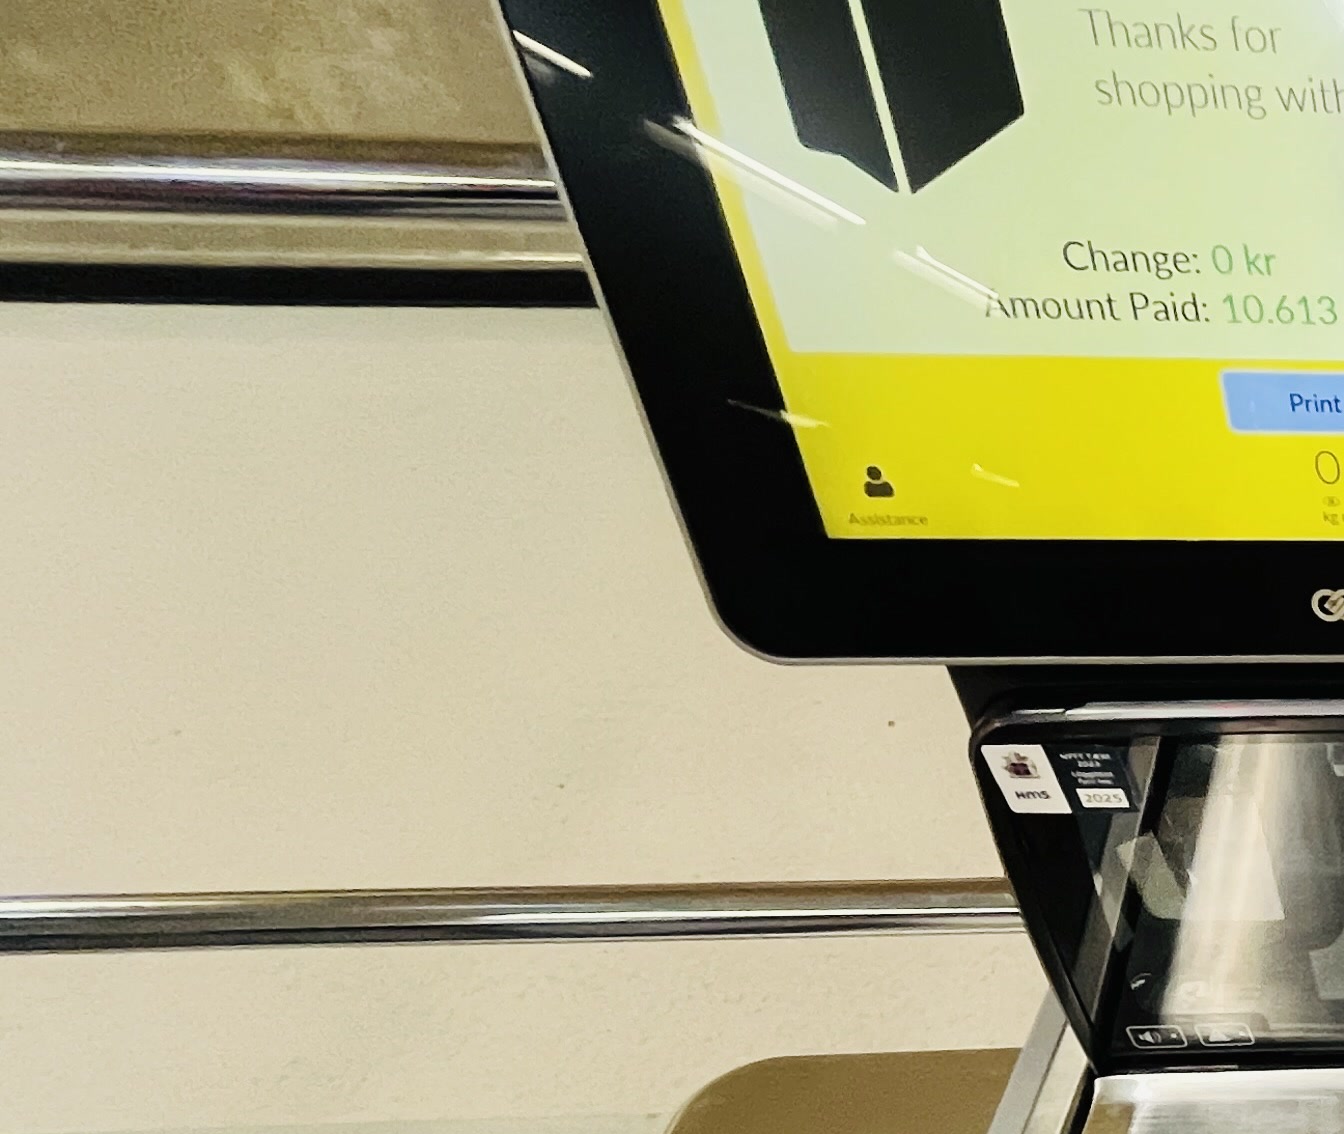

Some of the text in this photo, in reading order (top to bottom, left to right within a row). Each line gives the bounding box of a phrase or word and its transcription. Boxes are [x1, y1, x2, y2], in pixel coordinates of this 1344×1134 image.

[1078, 8, 1282, 54] Thanks for
[1095, 69, 1267, 120] shopping
[1062, 240, 1276, 280] Change: 0 kr
[985, 291, 1121, 321] Amount
[1129, 291, 1210, 322] Paid:
[1222, 294, 1338, 326] 10.613
[1289, 393, 1342, 414] Print
